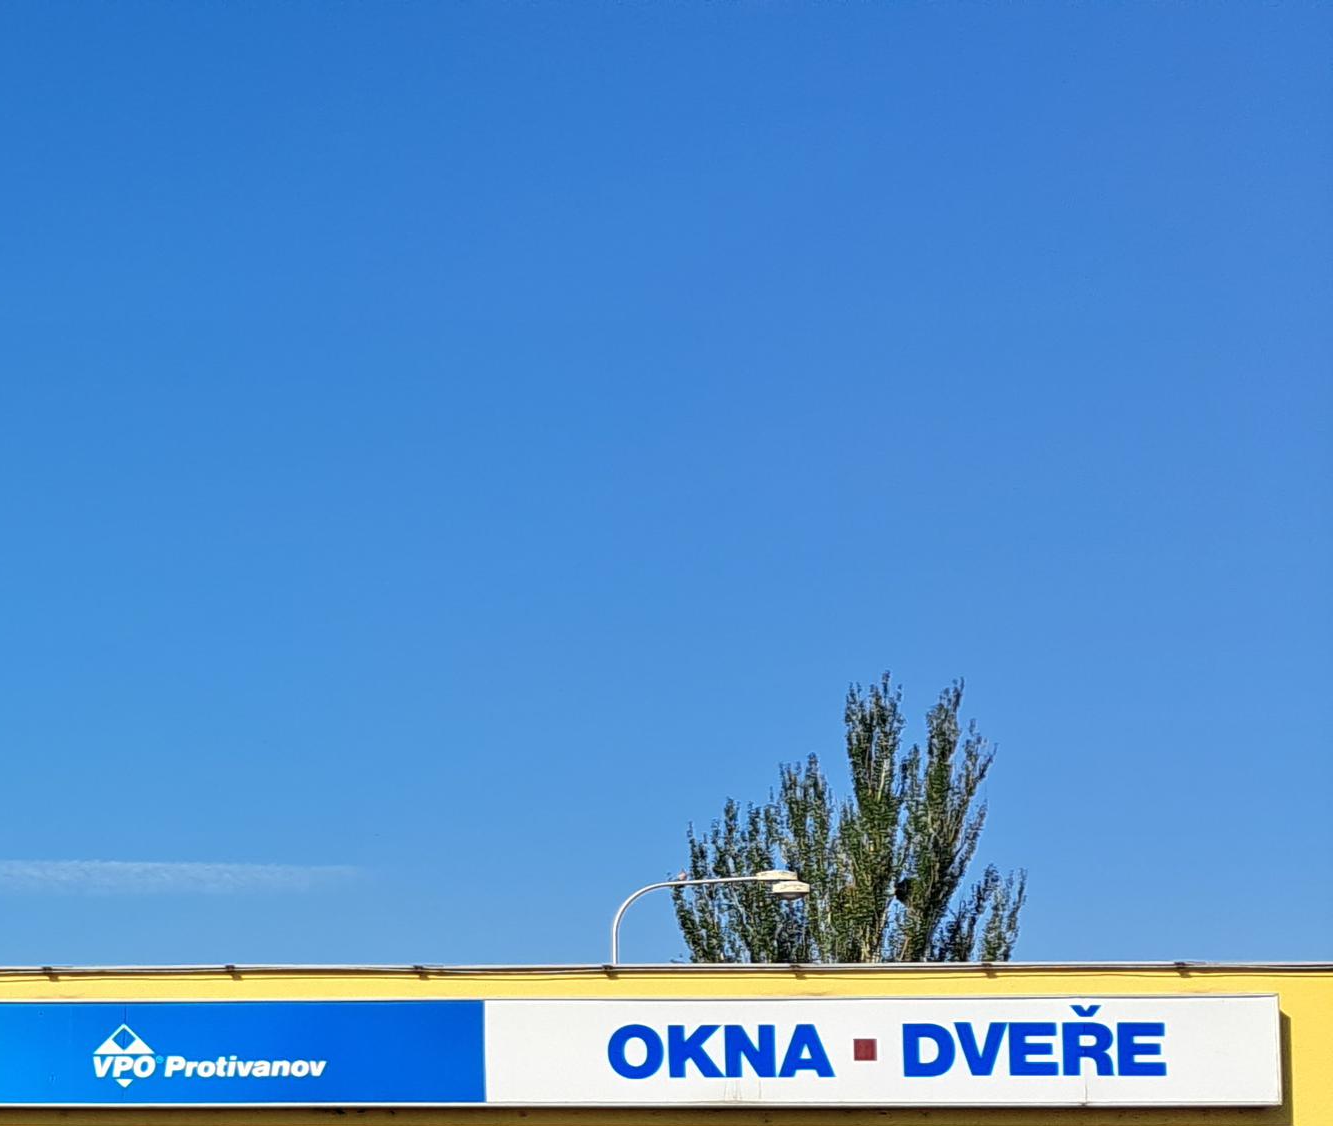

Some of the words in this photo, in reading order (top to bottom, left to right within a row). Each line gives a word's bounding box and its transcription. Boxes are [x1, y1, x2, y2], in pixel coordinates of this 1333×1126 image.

[607, 1023, 837, 1079] OKNA
[901, 1004, 1167, 1078] DVEŘE
[93, 1056, 156, 1078] VPO
[164, 1055, 326, 1078] Protivanov
